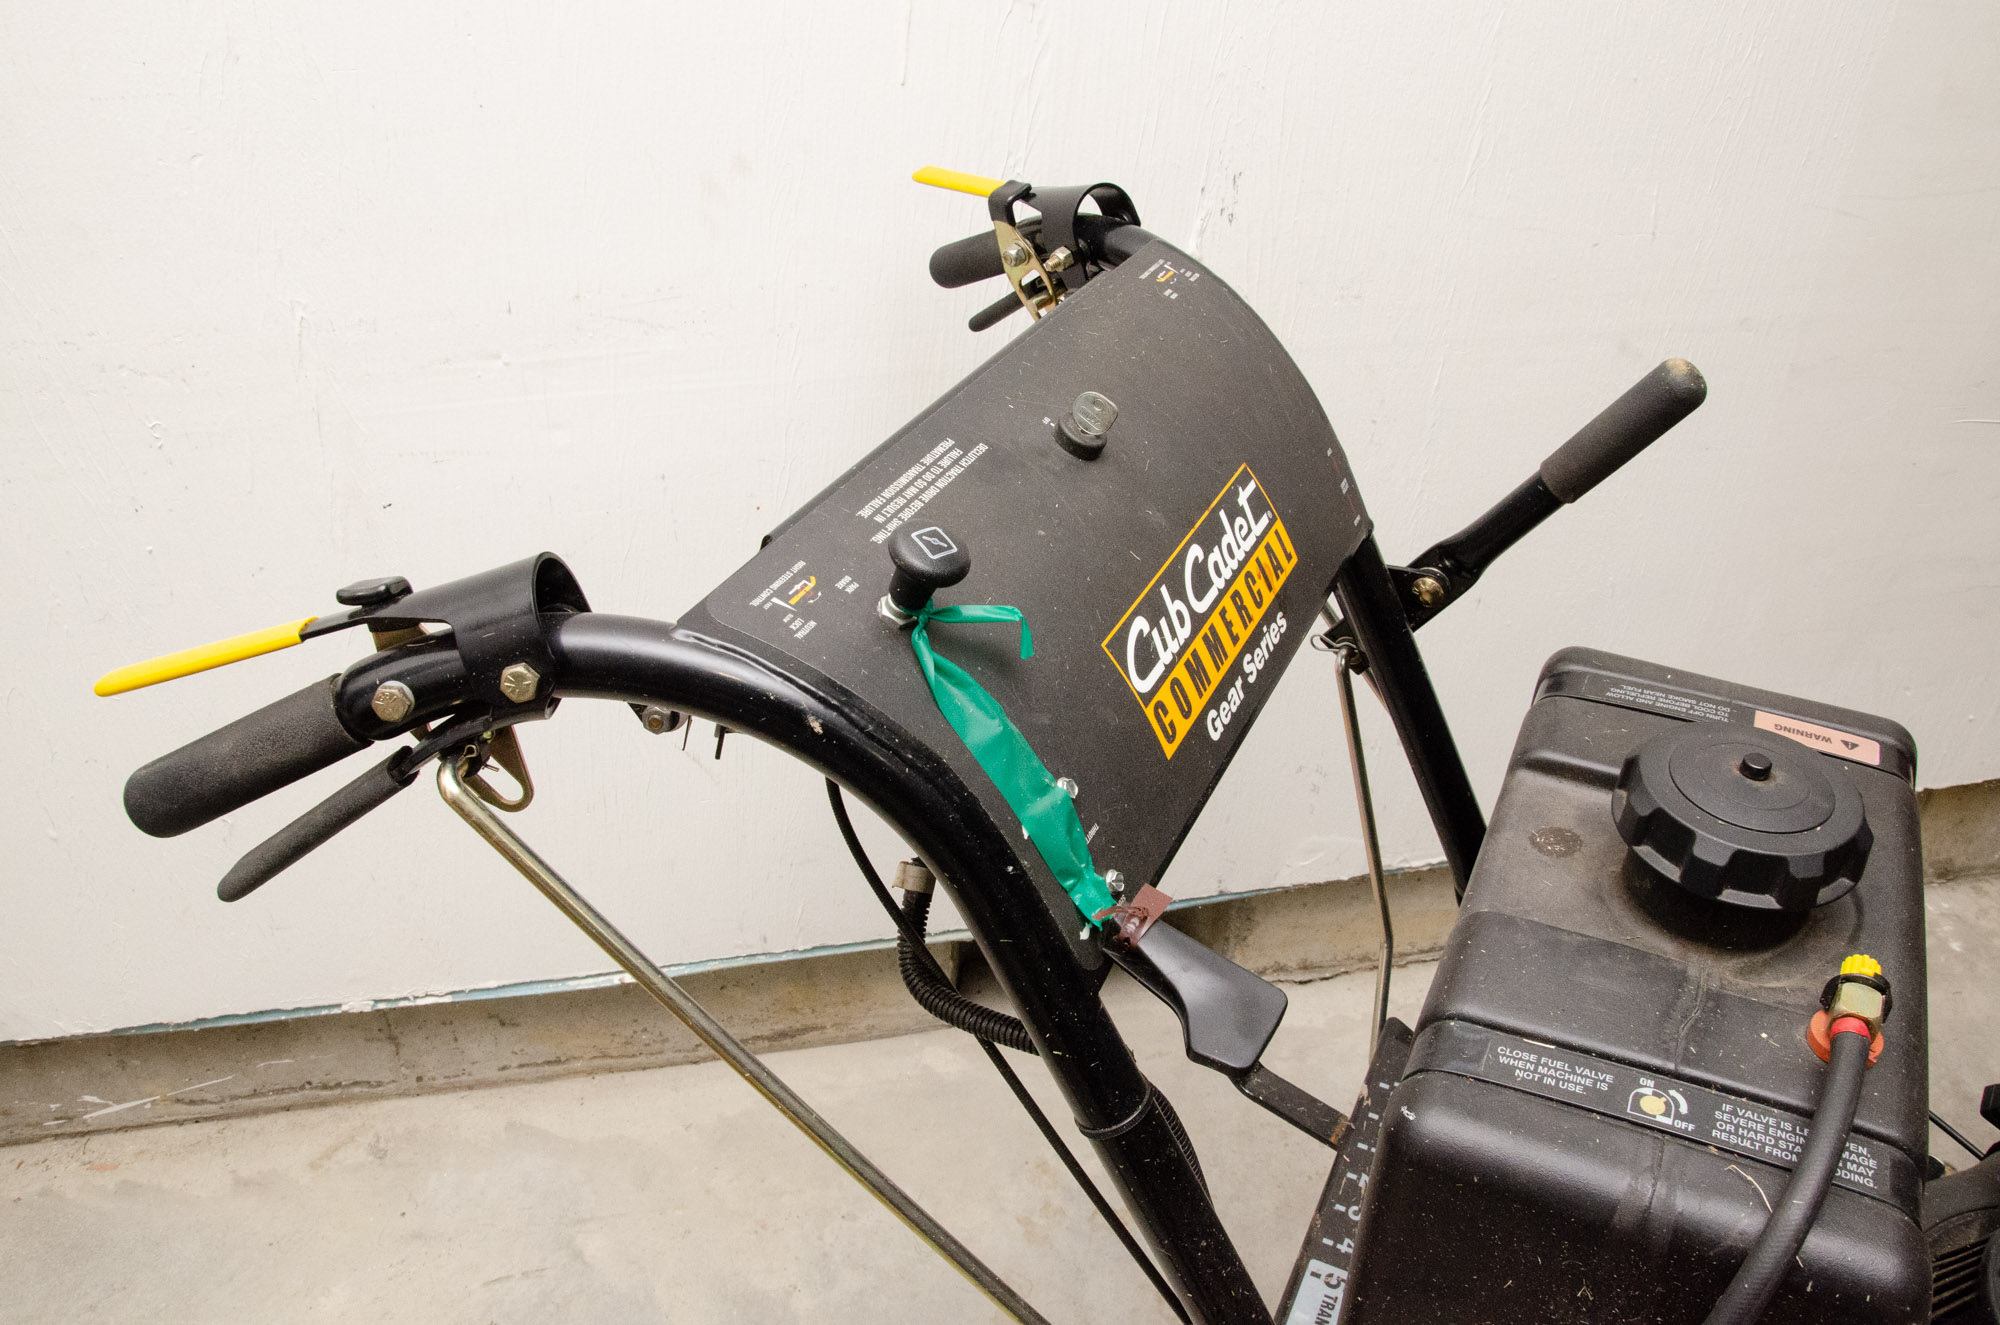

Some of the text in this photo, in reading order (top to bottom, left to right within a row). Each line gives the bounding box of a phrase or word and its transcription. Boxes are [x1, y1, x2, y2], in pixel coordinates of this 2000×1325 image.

[919, 437, 955, 467] PREMATURE
[873, 447, 963, 524] FAILURE TO DO SO MAY RESULT IN
[880, 462, 926, 500] TRANSMISSION
[870, 442, 989, 544] DECLUTCH TRACTION DRIVE BEFORE SHIFTING.
[749, 560, 806, 608] RIGHT STEERING CONTROL
[844, 581, 860, 594] PARK
[1127, 479, 1270, 693] Cub Cadet
[789, 618, 805, 631] LOCK
[794, 620, 817, 640] NEUTRAL
[1153, 528, 1293, 745] COMMERCIAL
[1206, 611, 1287, 741] Gear Series
[1643, 689, 1666, 698] NEAR
[1659, 697, 1691, 709] BEFORE
[1667, 694, 1697, 704] SMOKE
[1699, 700, 1716, 709] NOT
[1605, 691, 1729, 723] TURN OFF ENGINE AND ALLOW
[1692, 704, 1716, 714] COOL
[1717, 709, 1729, 717] TO
[1774, 723, 1833, 744] WARNING
[1497, 1046, 1614, 1083] CLOSE FUEL VALVE
[1499, 1055, 1608, 1091] WHEN MACHINE IS
[1515, 1069, 1586, 1094] NOT IN USE.
[1640, 1077, 1655, 1087] ON
[1674, 1120, 1696, 1131] OFF
[1722, 1103, 1734, 1112] IF
[1736, 1107, 1777, 1127] VALVE
[1780, 1121, 1792, 1131] IS
[1712, 1129, 1761, 1150] RESULT
[1714, 1110, 1878, 1169] SEVERE ENGIN MAGE
[1716, 1121, 1735, 1133] OR
[1739, 1128, 1775, 1145] HARD
[1847, 1161, 1875, 1177] MAY
[1336, 1237, 1355, 1254] 4
[1323, 1273, 1346, 1289] 5
